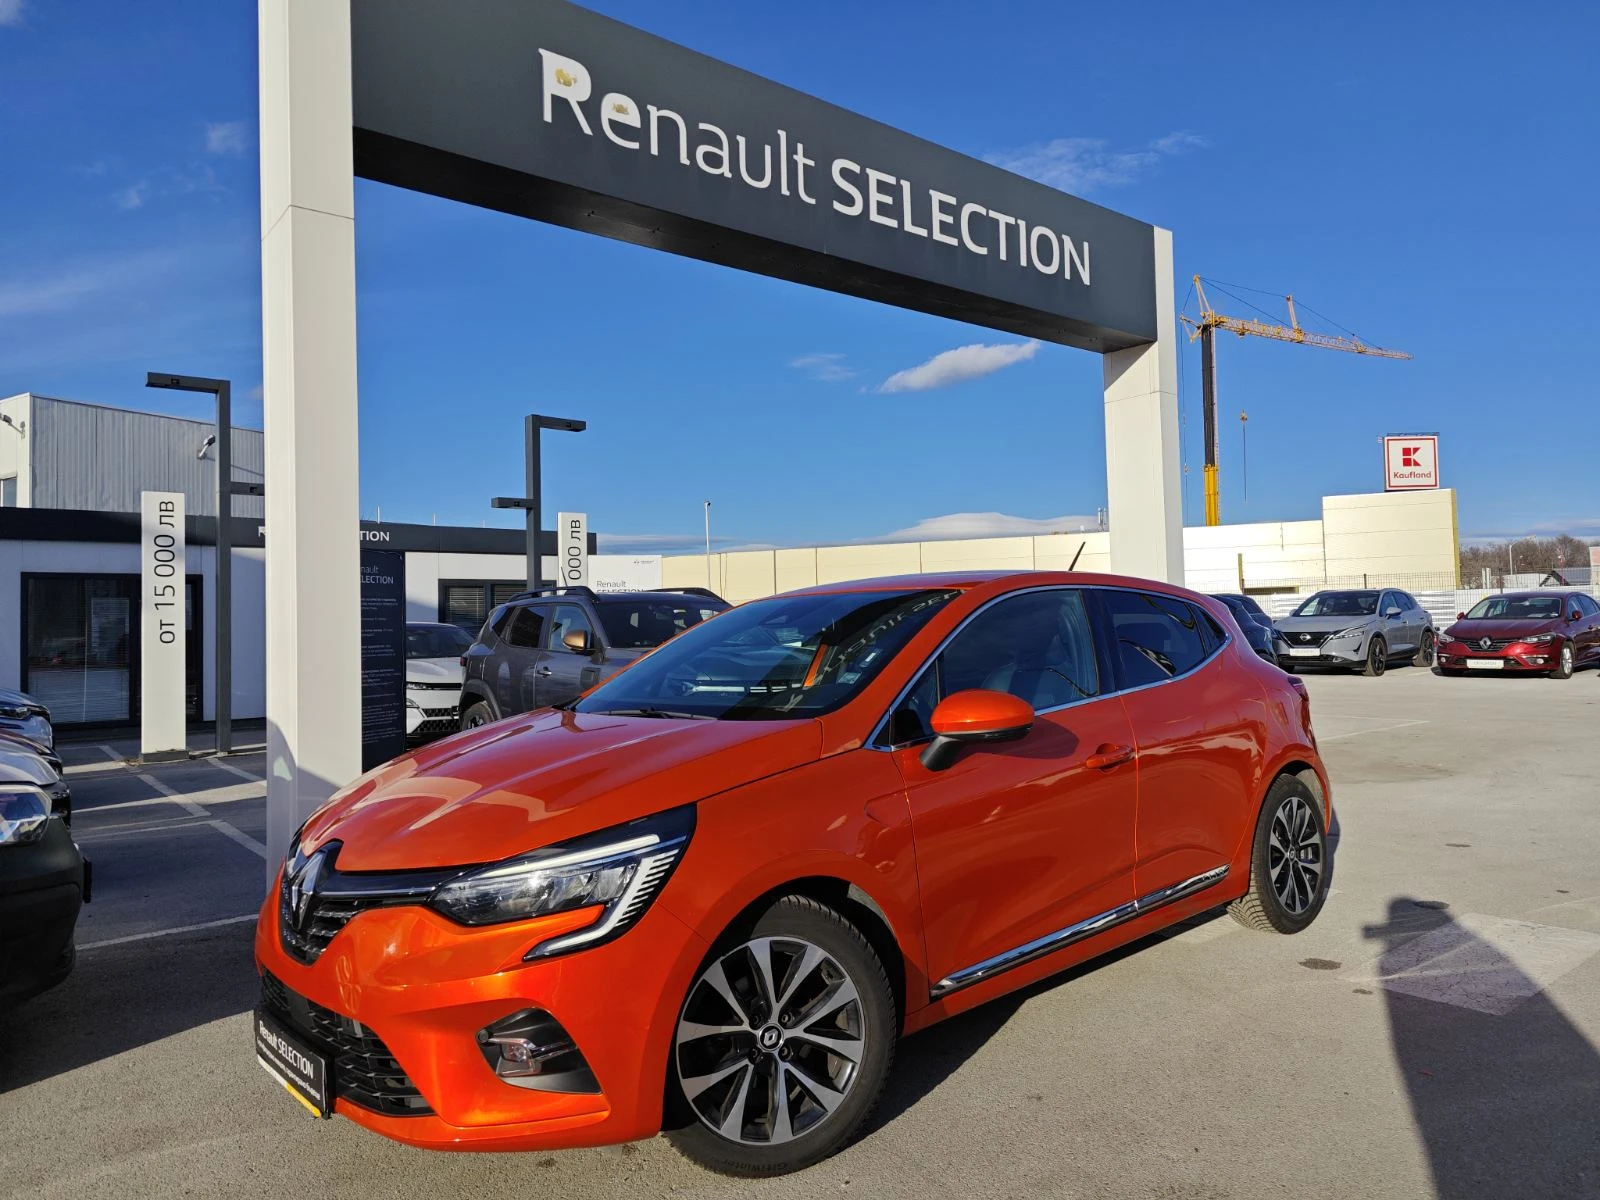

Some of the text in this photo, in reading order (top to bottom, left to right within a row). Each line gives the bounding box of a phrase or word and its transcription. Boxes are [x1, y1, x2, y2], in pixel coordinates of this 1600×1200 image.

[538, 47, 1092, 286] Renault SELECTION
[1393, 471, 1432, 479] Kaufland
[154, 534, 176, 577] 000
[567, 546, 582, 580] 000
[361, 565, 380, 574] nault
[361, 575, 394, 585] LECTION
[596, 580, 627, 588] Renault
[154, 585, 176, 611] 15
[277, 1038, 314, 1079] SELECTION
